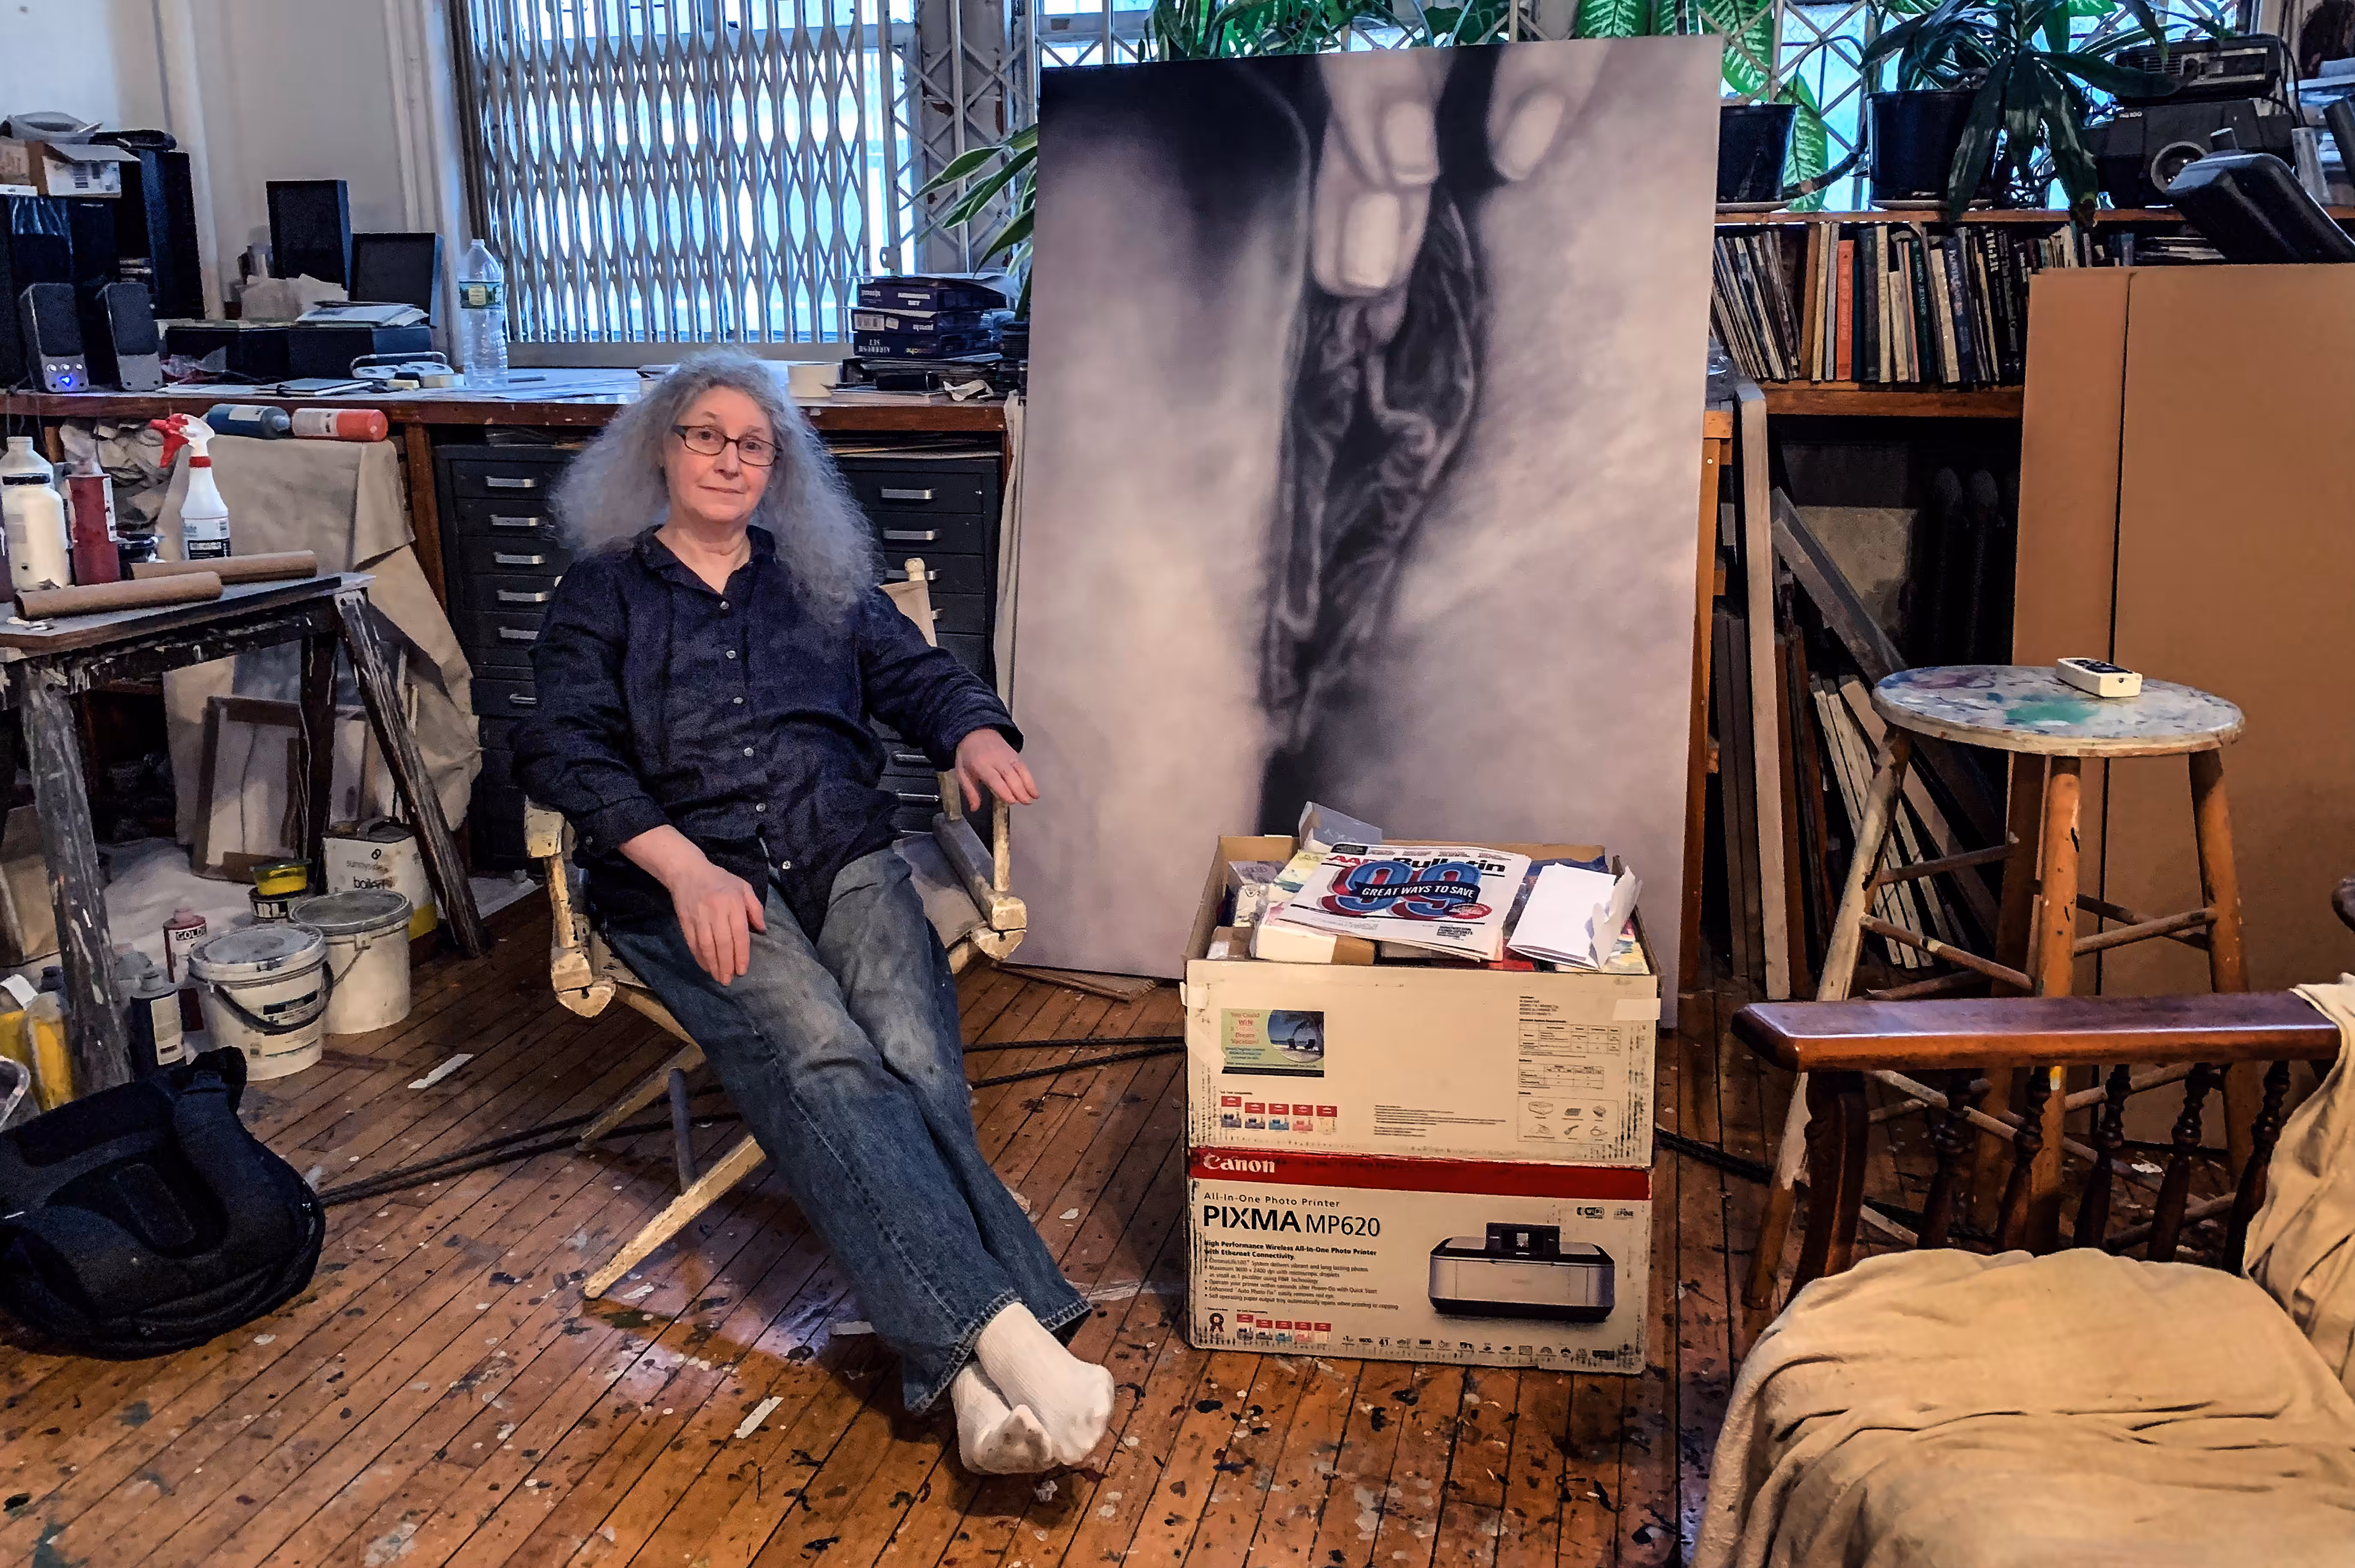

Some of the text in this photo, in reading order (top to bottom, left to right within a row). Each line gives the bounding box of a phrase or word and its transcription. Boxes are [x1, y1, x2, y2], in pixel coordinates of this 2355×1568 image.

[1393, 858, 1506, 872] Bulltin
[1362, 887, 1399, 896] GREAT
[1401, 885, 1432, 895] WAYS
[1449, 886, 1475, 898] SAVE
[1203, 1152, 1275, 1173] Canon
[1204, 1192, 1340, 1207] All-In-One Photo Printer
[1203, 1205, 1380, 1237] PIXMA MP620
[1221, 1241, 1264, 1249] Performance
[1295, 1245, 1330, 1253] All-In-One
[1221, 1249, 1250, 1257] Ethernet
